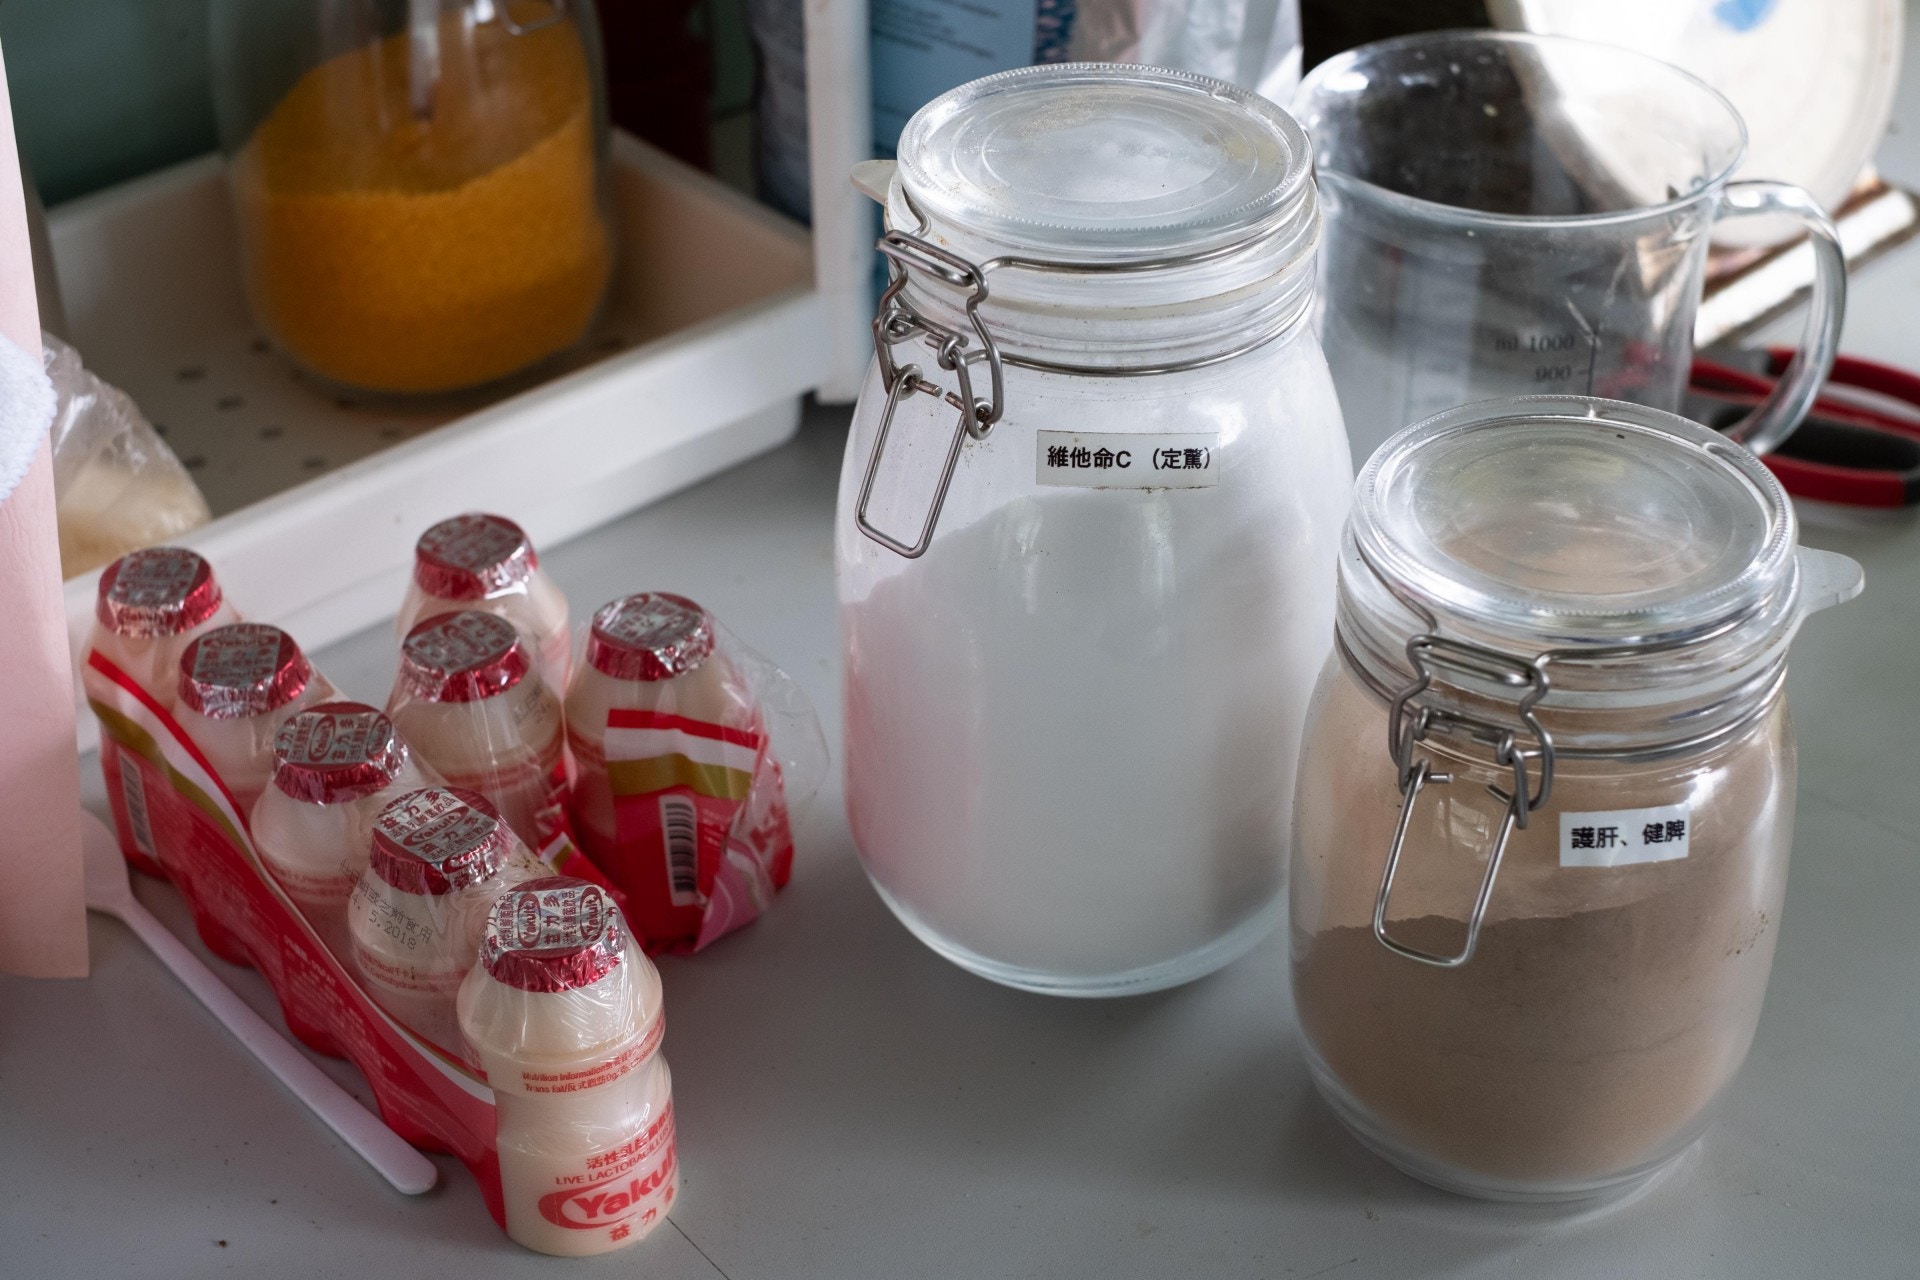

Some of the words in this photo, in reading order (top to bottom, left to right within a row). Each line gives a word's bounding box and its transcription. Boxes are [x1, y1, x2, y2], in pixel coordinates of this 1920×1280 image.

[1529, 334, 1575, 353] 1000
[1535, 364, 1572, 382] 900
[416, 813, 461, 841] Yakult
[523, 901, 537, 939] Yakult
[555, 1175, 585, 1185] LIVE
